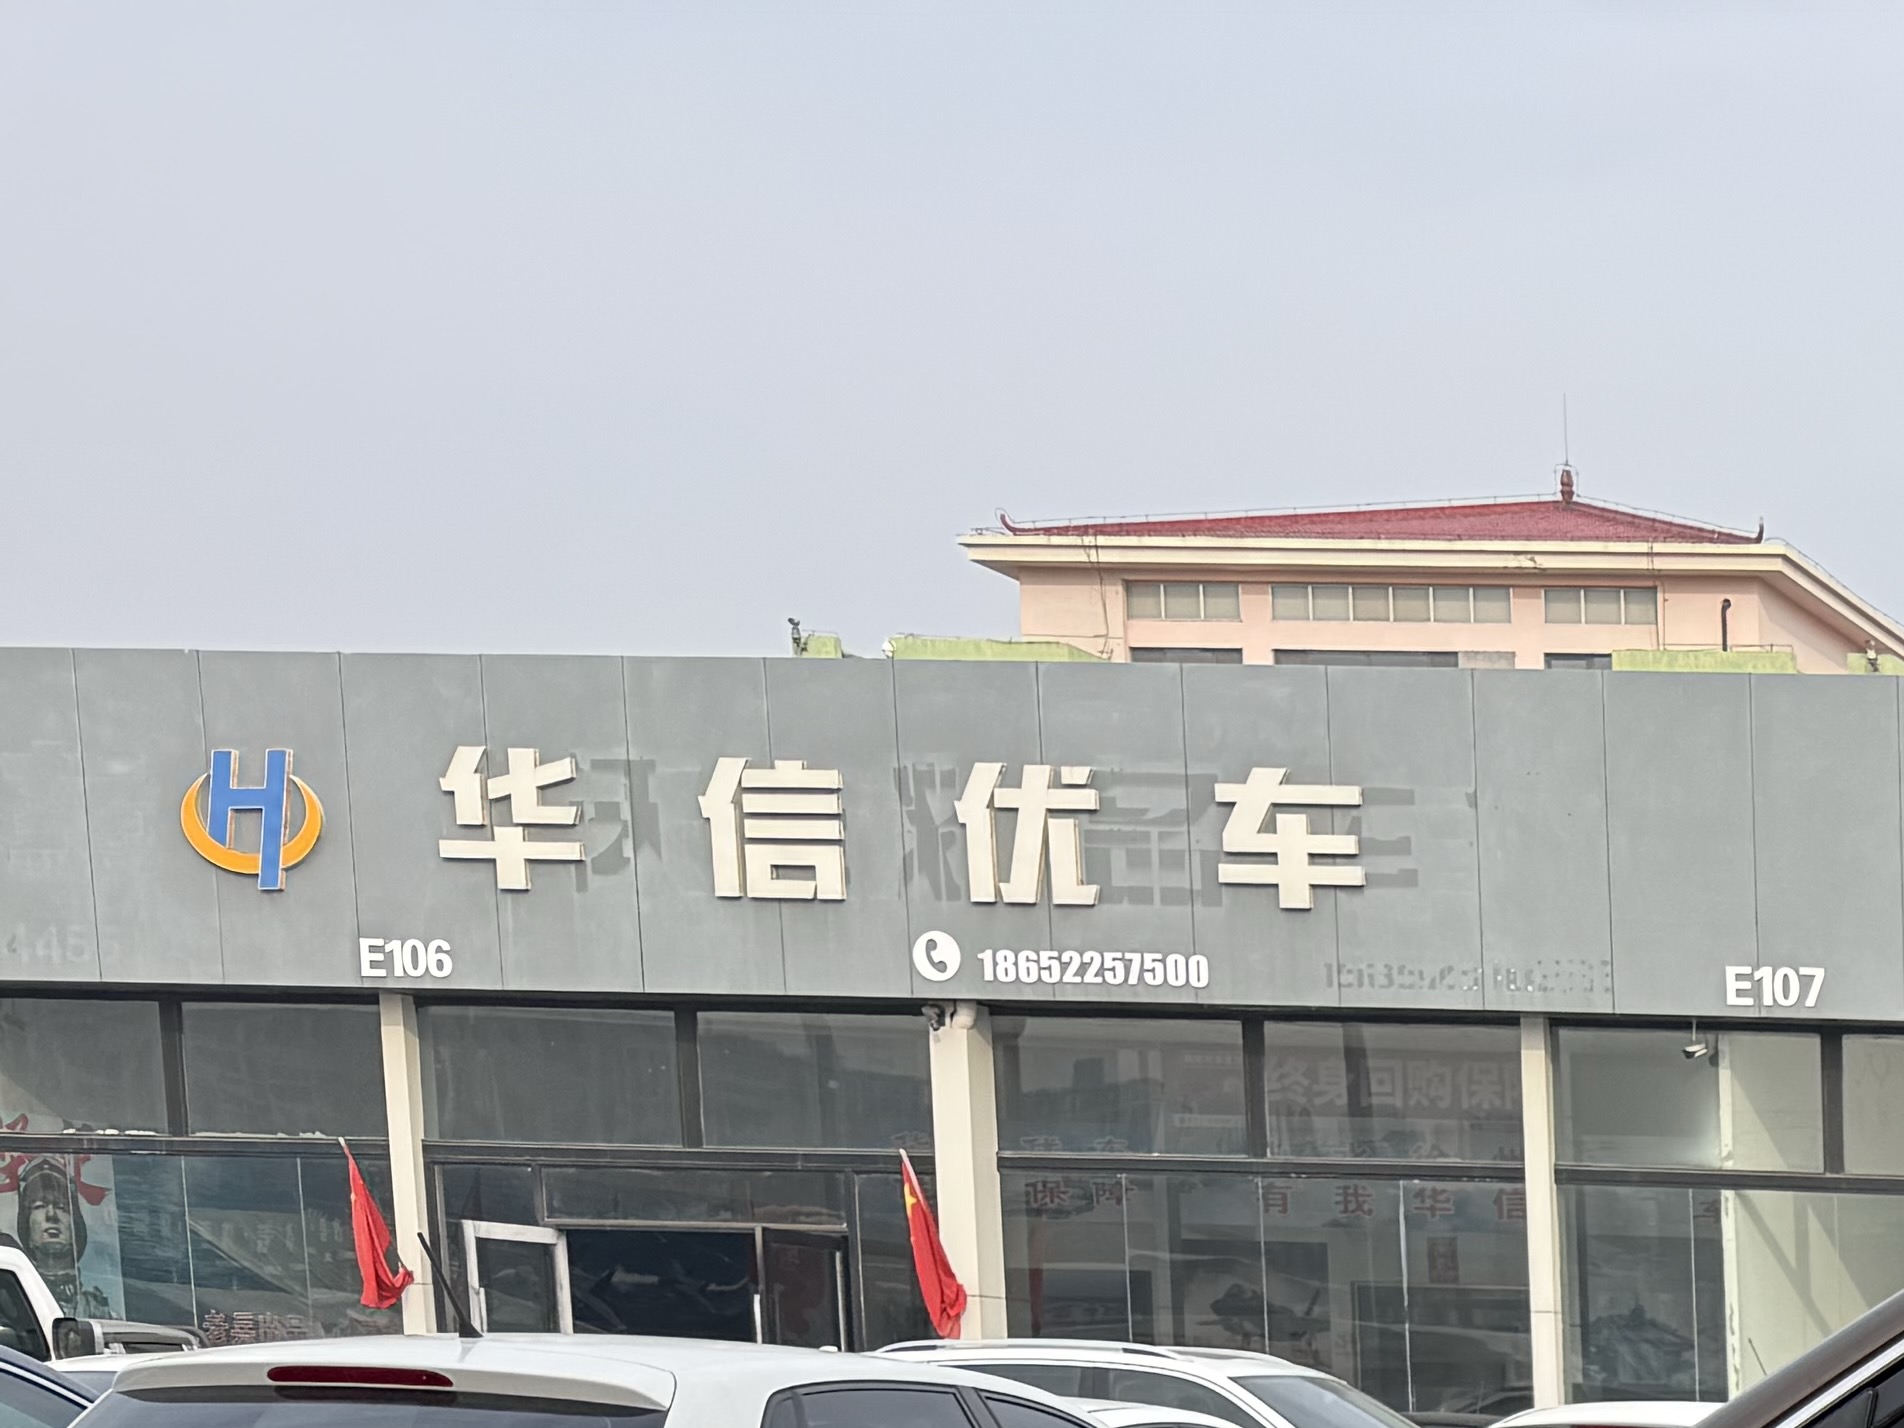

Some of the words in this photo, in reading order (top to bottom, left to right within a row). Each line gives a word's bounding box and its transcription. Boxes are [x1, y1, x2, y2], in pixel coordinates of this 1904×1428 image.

[438, 745, 1366, 910] 华信优车
[359, 937, 453, 979] E106
[977, 948, 1209, 988] 18652257500
[1724, 965, 1825, 1008] E107
